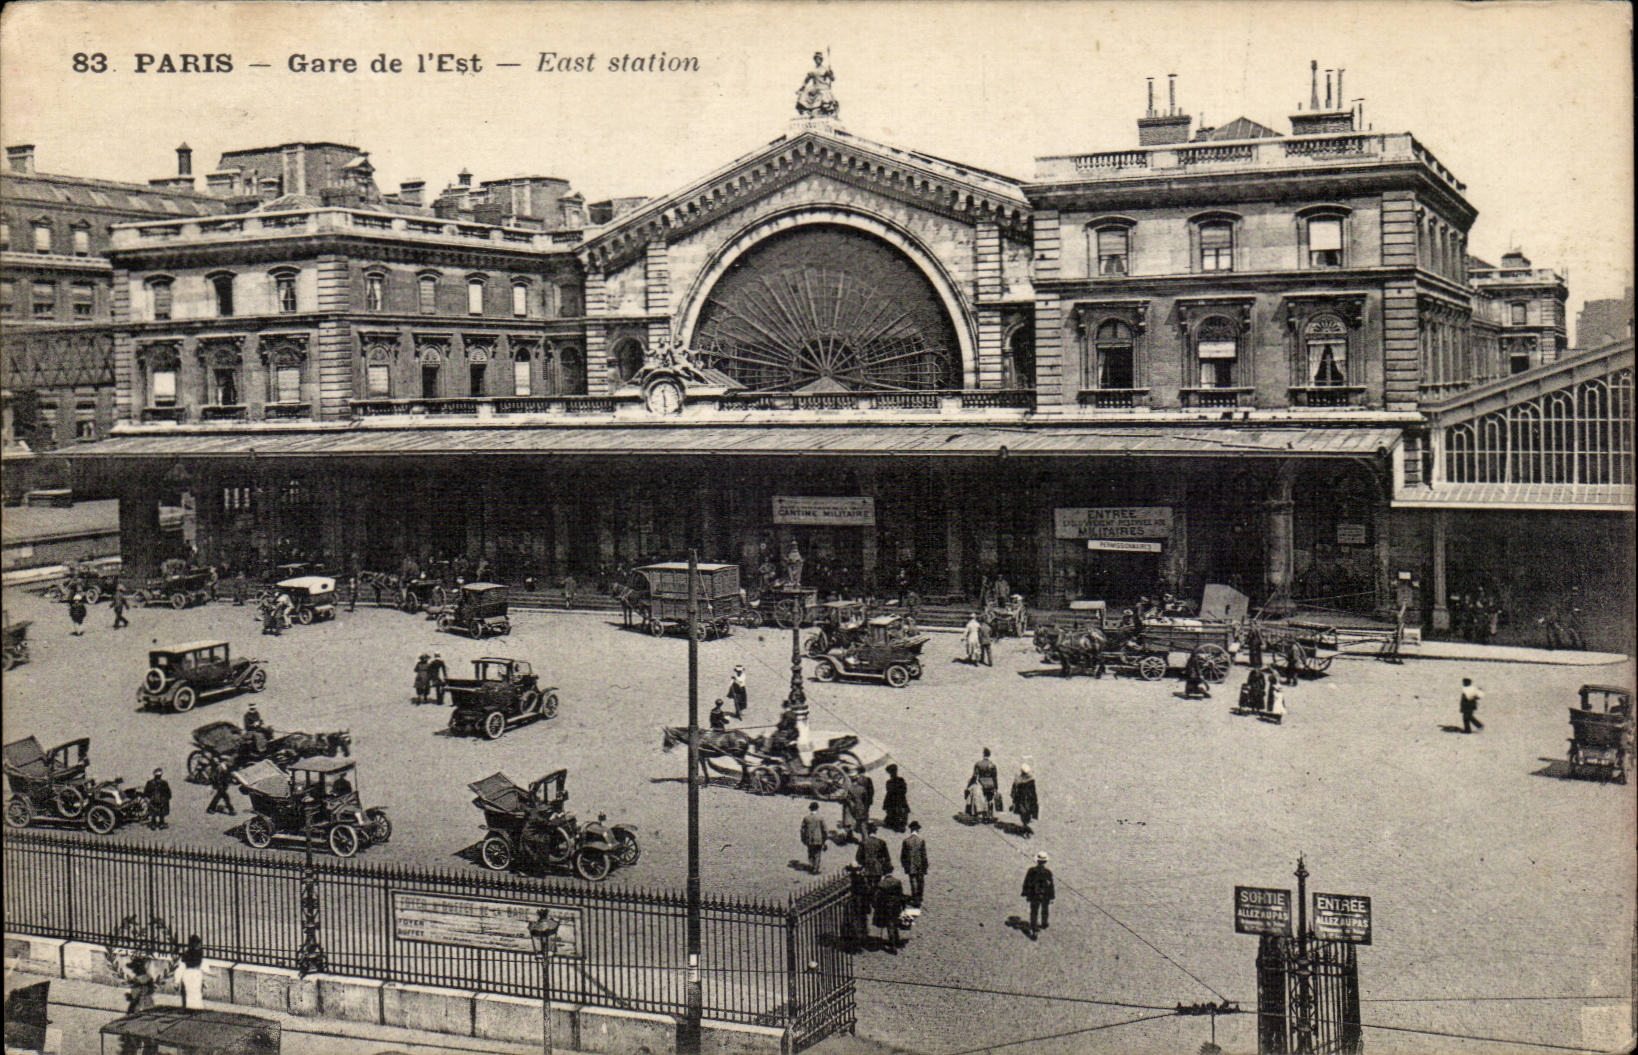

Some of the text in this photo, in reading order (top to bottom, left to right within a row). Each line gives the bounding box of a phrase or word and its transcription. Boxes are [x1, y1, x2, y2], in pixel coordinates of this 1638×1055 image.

[823, 510, 870, 518] MILITAIRE
[1078, 526, 1145, 536] MILITAIRES
[1240, 890, 1286, 906] SORTIE
[1237, 908, 1260, 918] ALLEZ
[1272, 911, 1289, 921] PAS
[398, 918, 425, 927] FOYER
[1316, 915, 1340, 926] ALLEZ
[1351, 918, 1369, 928] PAS
[397, 927, 425, 937] BUFFET
